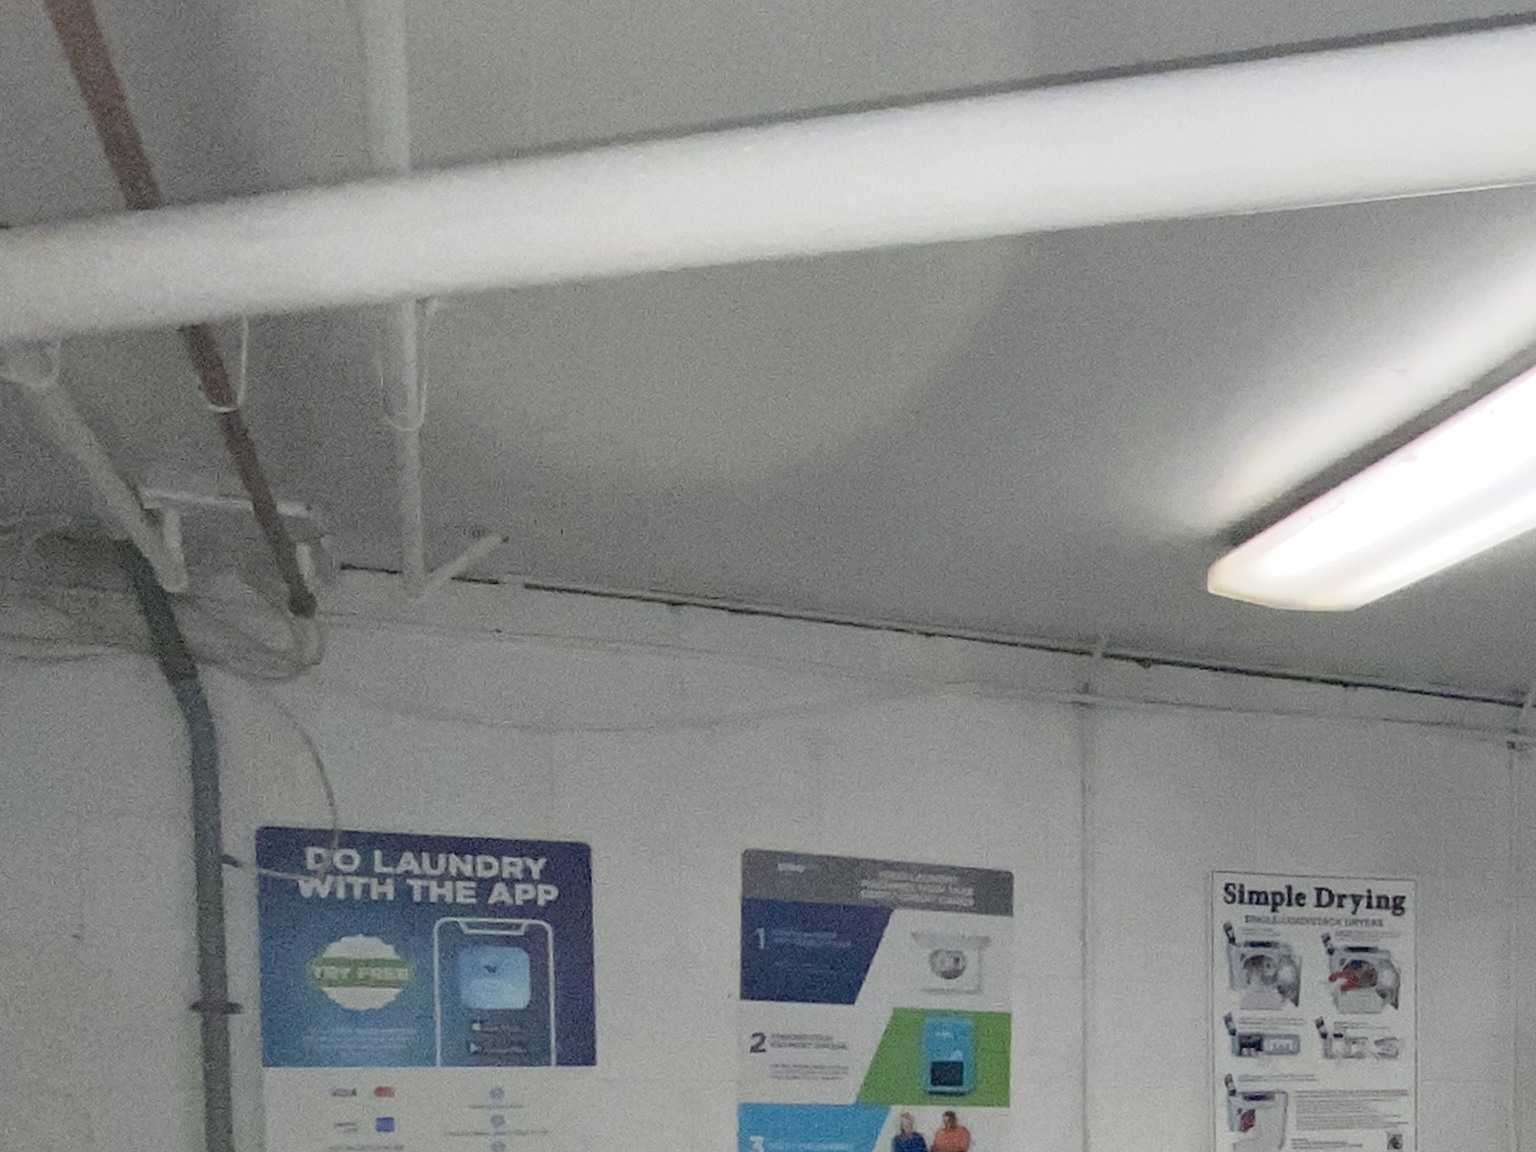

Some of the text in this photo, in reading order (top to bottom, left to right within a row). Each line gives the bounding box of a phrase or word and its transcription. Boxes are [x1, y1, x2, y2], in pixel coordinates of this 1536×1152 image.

[305, 846, 547, 880] DO LAUNDRY
[297, 876, 559, 906] WITH THE APP
[1223, 883, 1406, 915] Simple Drying
[754, 927, 766, 950] 1
[750, 1032, 767, 1053] 2
